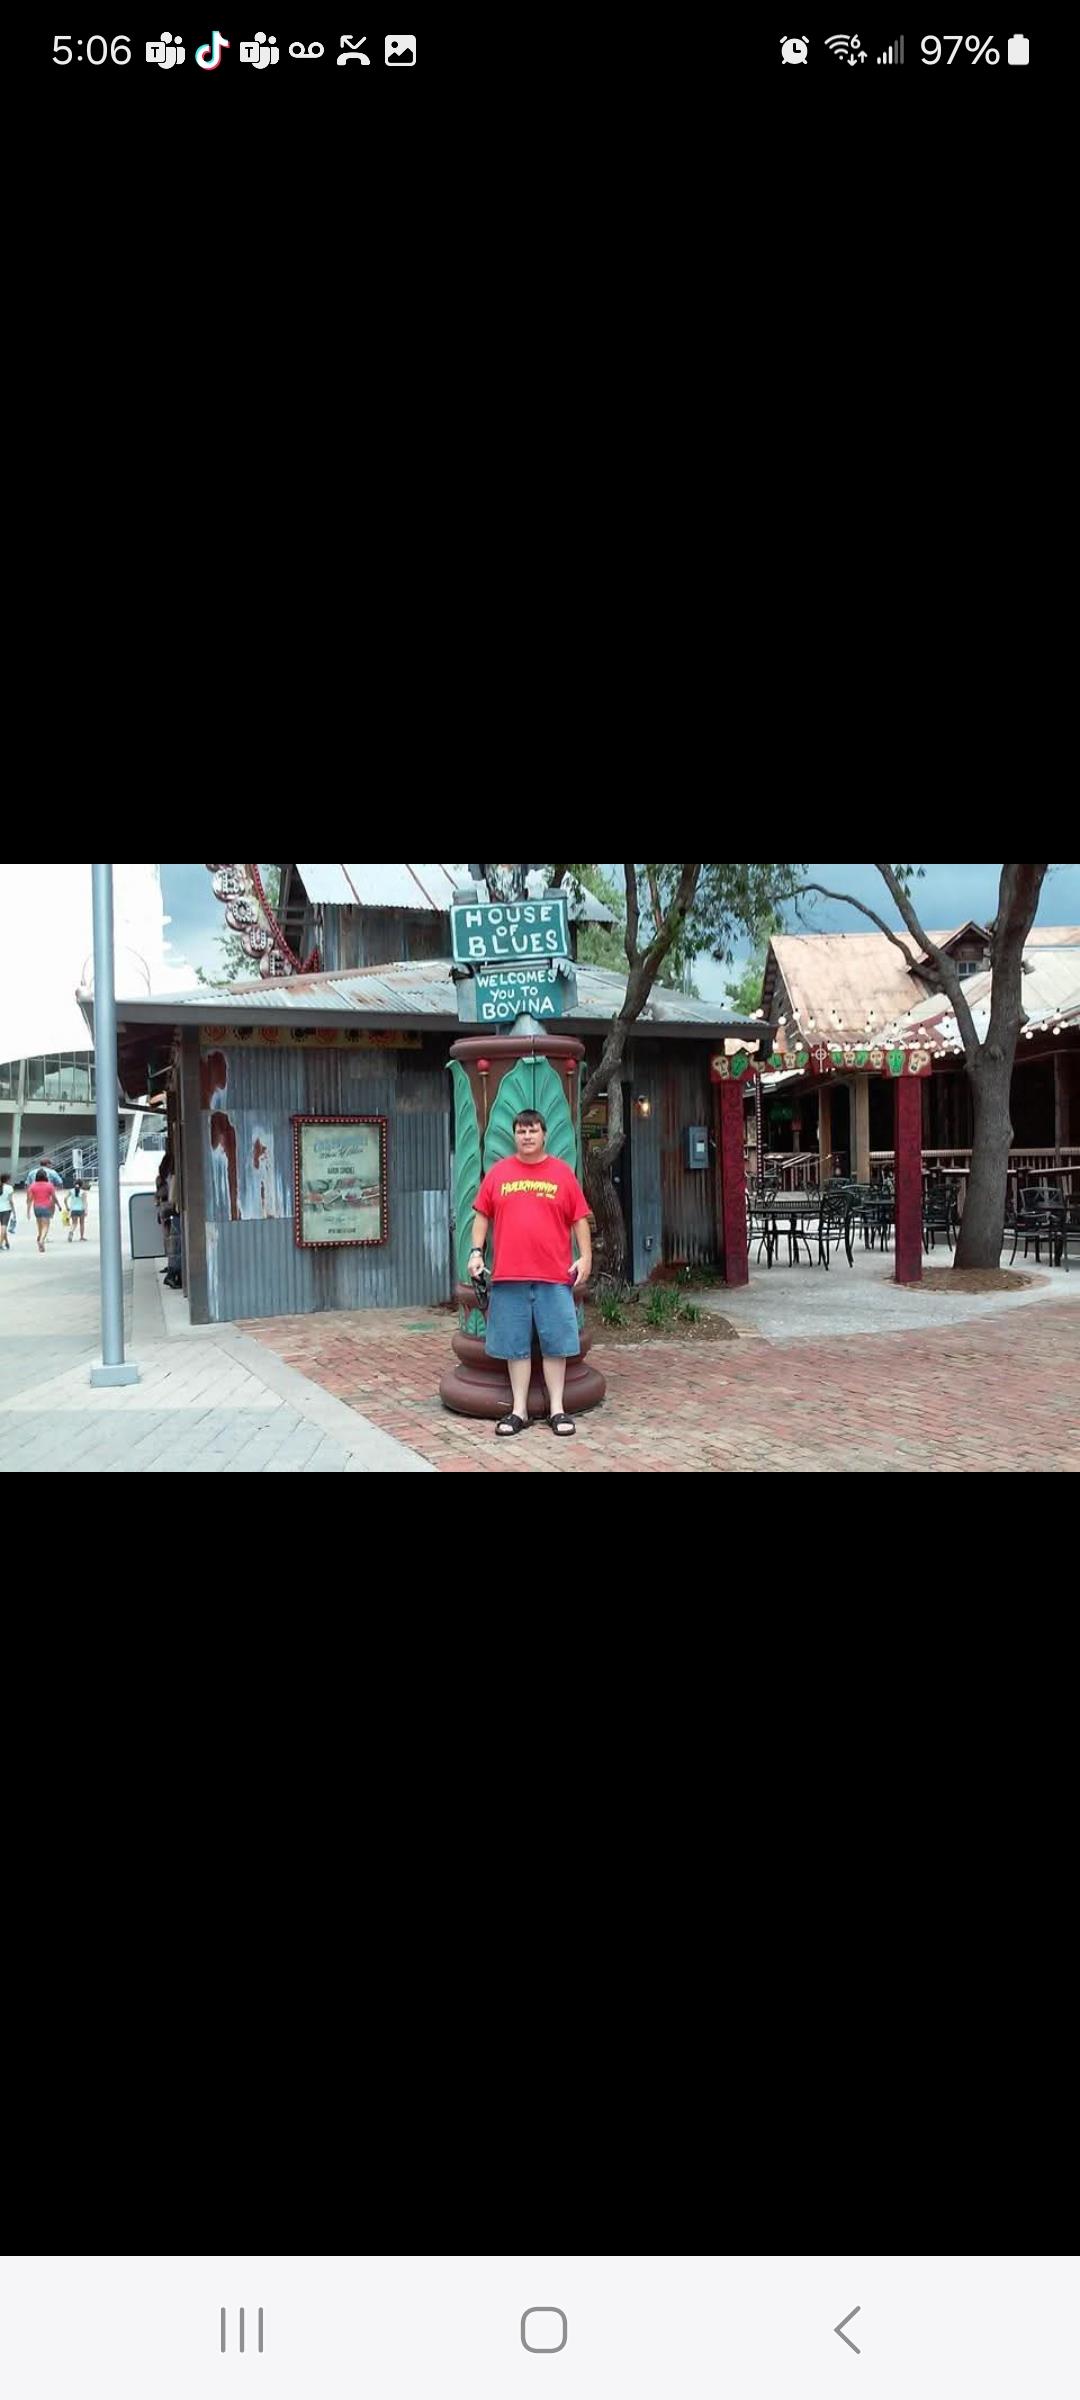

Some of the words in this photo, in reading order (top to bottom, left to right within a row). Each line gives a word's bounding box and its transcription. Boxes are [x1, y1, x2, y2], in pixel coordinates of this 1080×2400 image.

[465, 906, 553, 928] HOUSE
[496, 924, 519, 937] OF
[468, 929, 558, 957] BLUES
[477, 970, 557, 988] WELCOMES
[490, 988, 515, 1002] YOU
[521, 985, 538, 996] TO
[482, 996, 555, 1019] BOVINA
